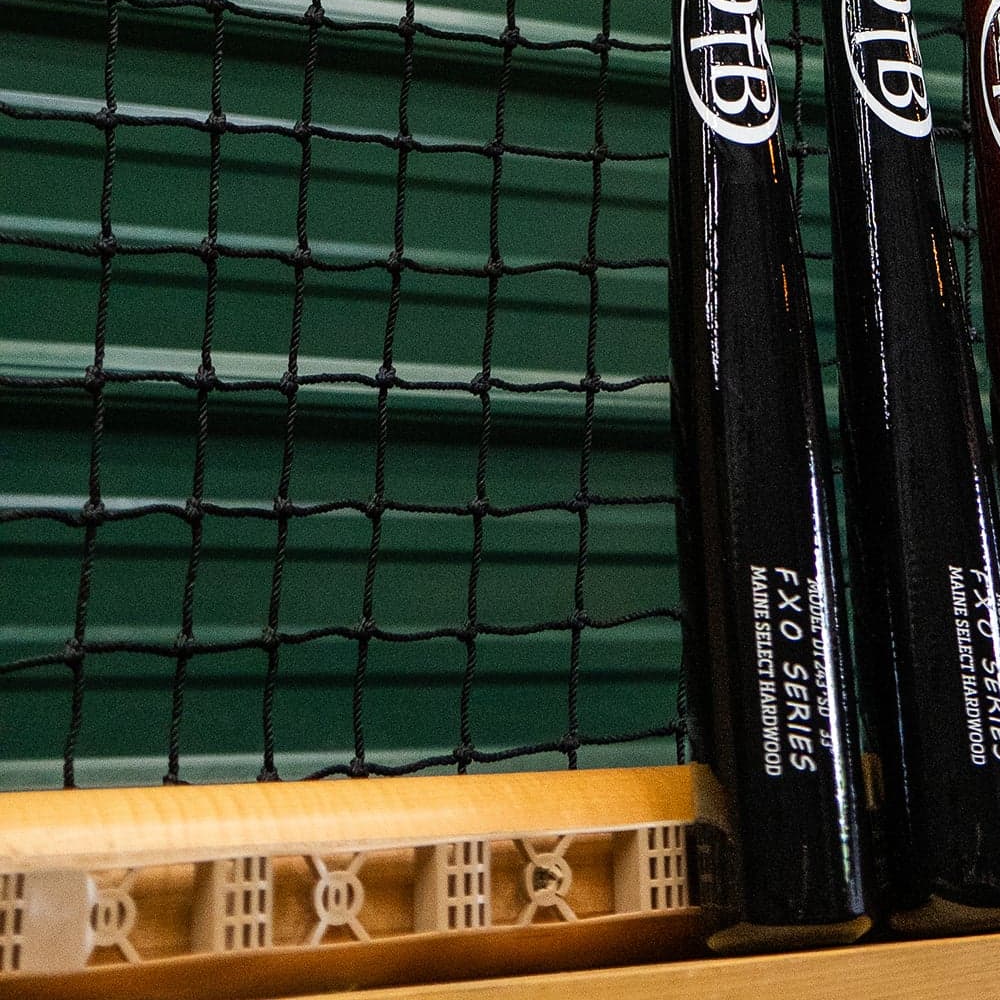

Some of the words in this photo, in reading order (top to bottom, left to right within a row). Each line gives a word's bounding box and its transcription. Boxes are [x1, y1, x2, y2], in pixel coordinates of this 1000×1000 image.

[750, 564, 770, 619] MAINE
[949, 565, 968, 617] MAINE
[754, 621, 775, 678] SELECT
[955, 618, 974, 673] SELECT
[759, 679, 782, 776] HARDWOOD
[782, 660, 817, 772] SERIES
[961, 673, 987, 766] HARDWOOD
